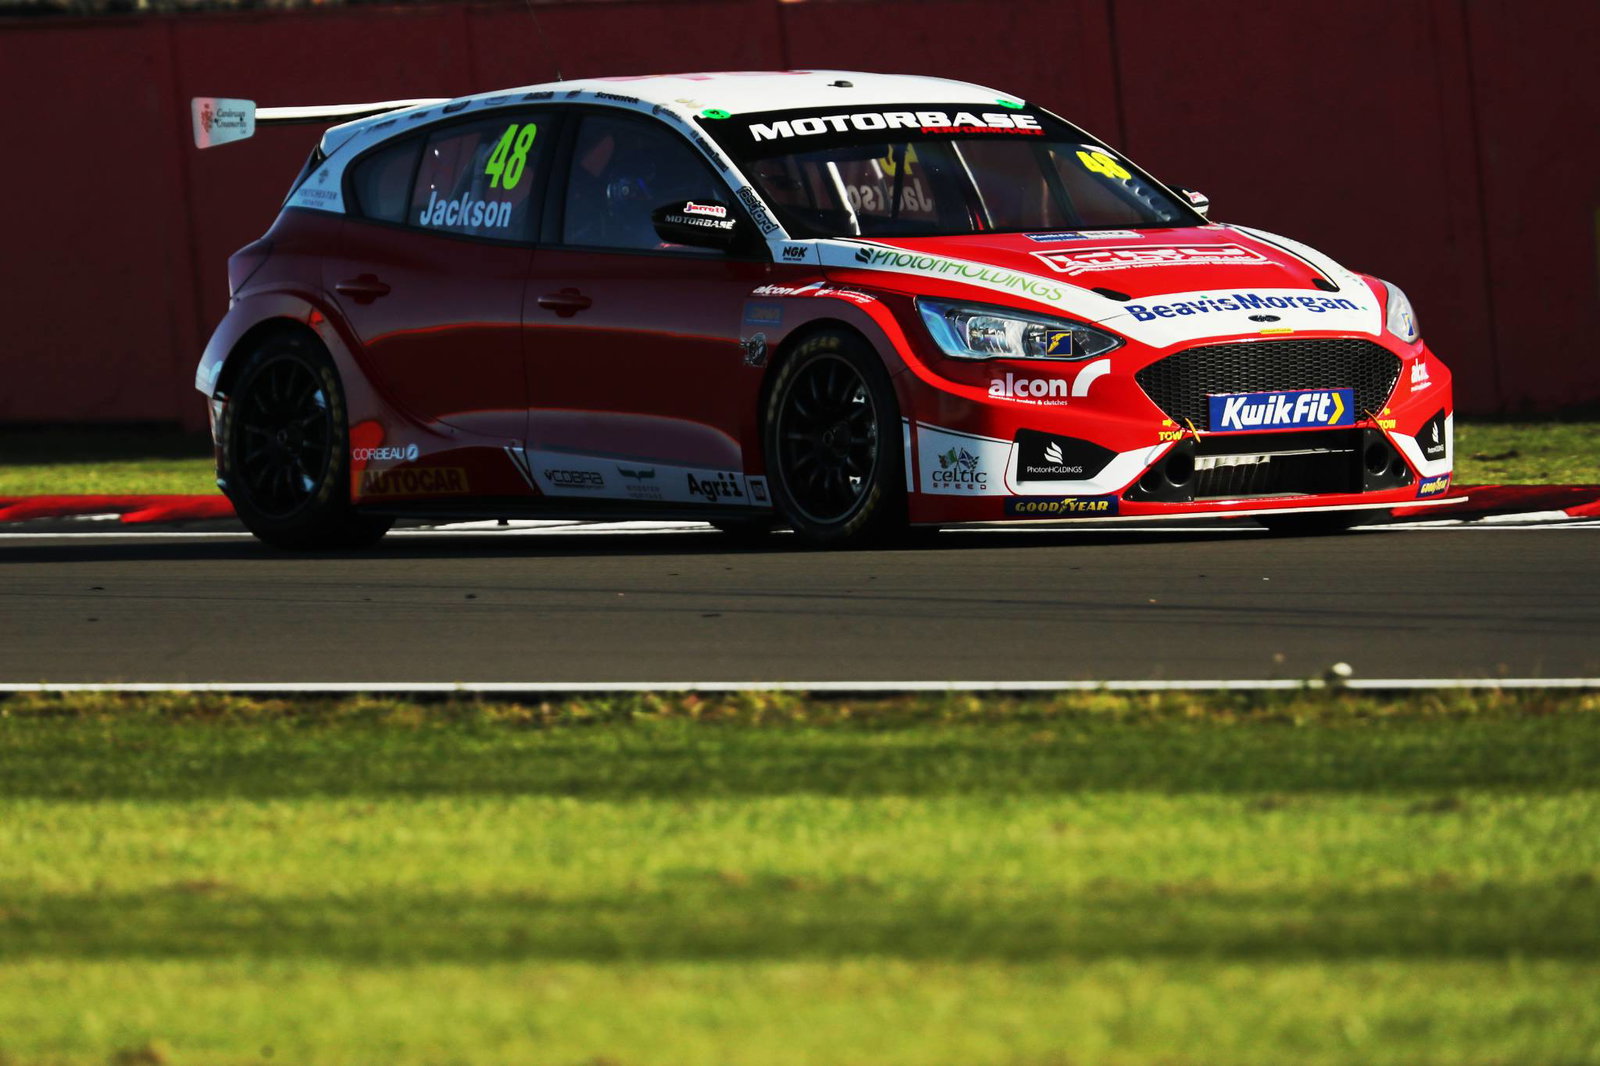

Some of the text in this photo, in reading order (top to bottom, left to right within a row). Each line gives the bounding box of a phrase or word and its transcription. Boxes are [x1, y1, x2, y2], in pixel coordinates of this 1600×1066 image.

[749, 111, 1042, 142] MOTORBASE
[484, 122, 538, 190] 48
[1075, 150, 1132, 180] 48
[419, 190, 512, 229] Jackson
[664, 213, 737, 231] MOTORBASE
[782, 246, 809, 258] NGK
[988, 373, 1068, 400] alcon
[1158, 430, 1183, 441] TOW
[353, 447, 406, 461] CORBEAU
[359, 468, 463, 494] AUTOCAR
[1027, 465, 1083, 475] PhotonHOLDINGS
[687, 472, 743, 500] Agrii
